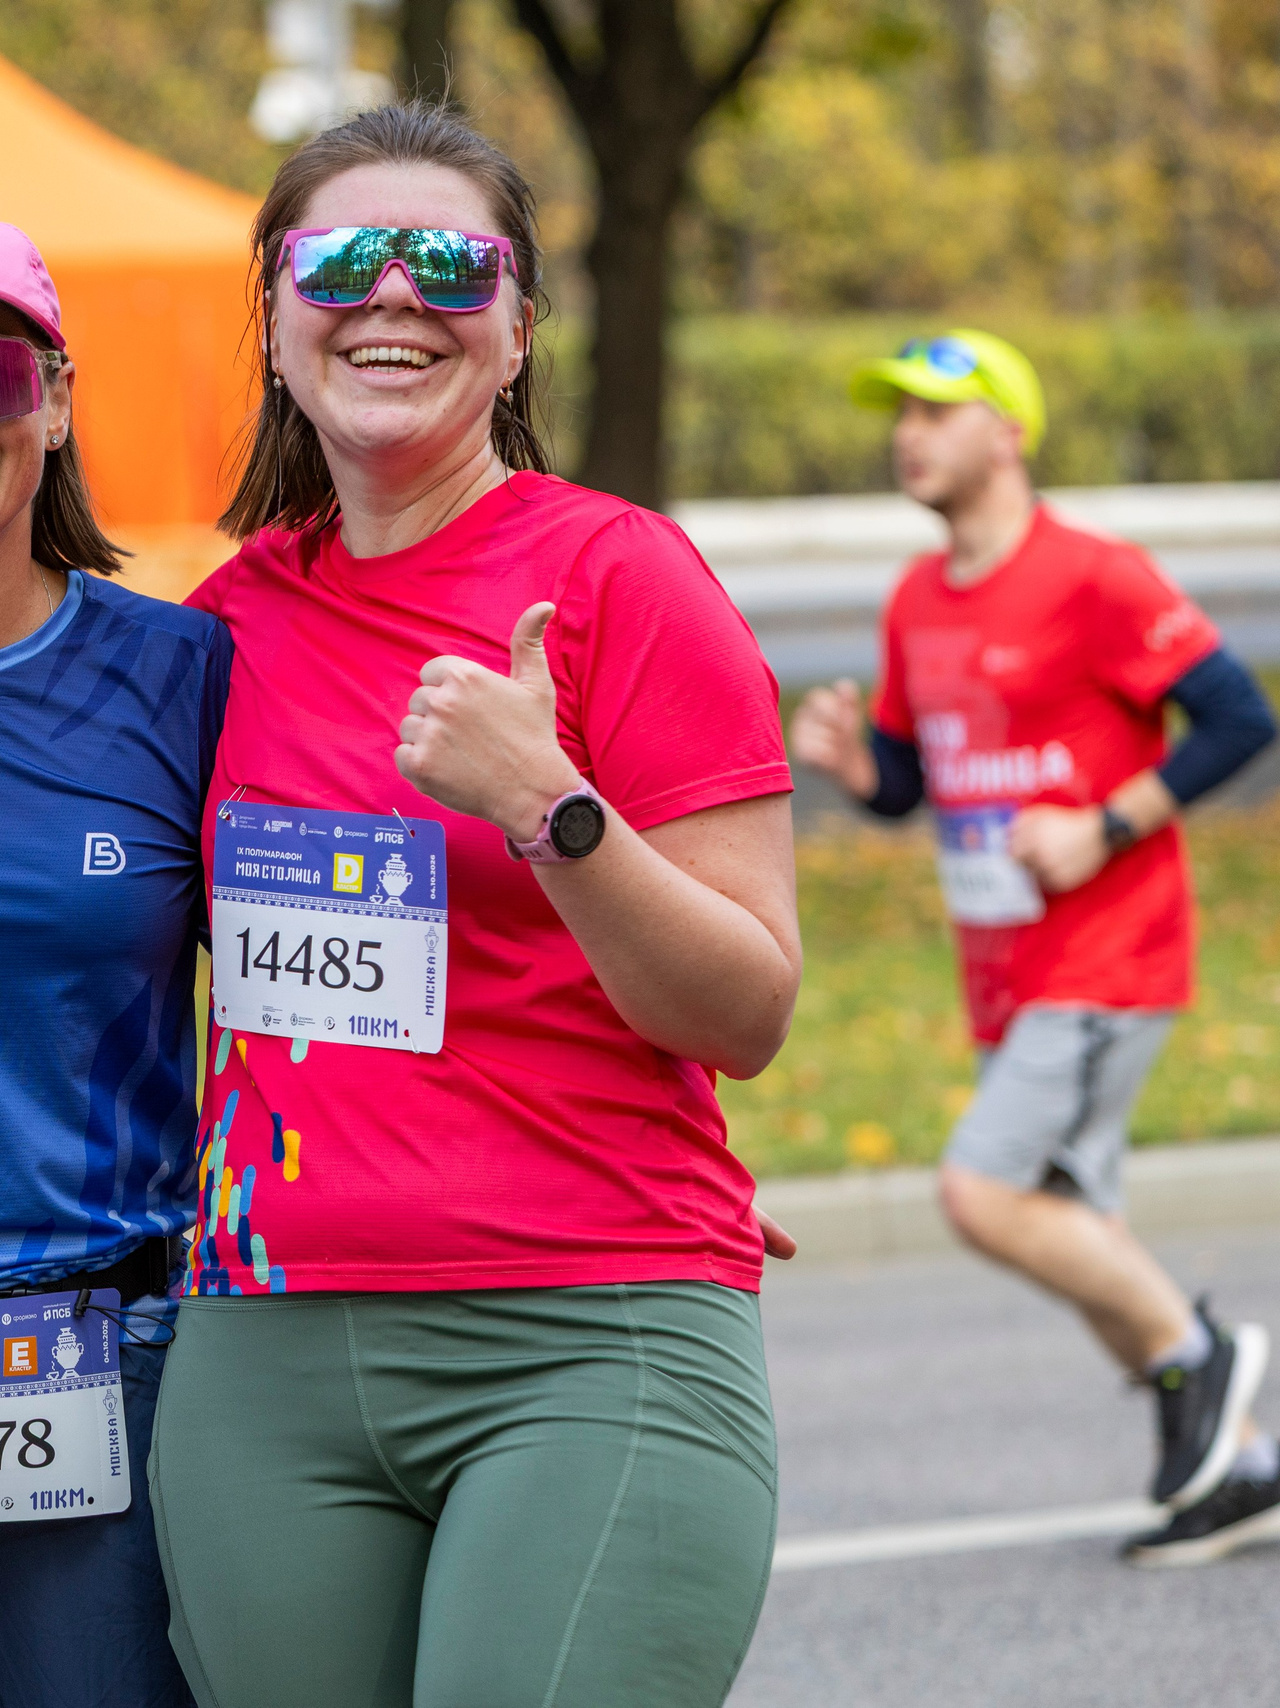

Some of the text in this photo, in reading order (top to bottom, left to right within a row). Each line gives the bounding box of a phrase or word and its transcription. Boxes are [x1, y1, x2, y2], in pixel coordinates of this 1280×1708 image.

[384, 832, 405, 845] ПСБ
[244, 847, 303, 862] ПОЛУМАРАФОН
[235, 861, 321, 885] МОЯ СТОЛИЦА
[337, 856, 361, 884] D
[429, 854, 437, 900] 04.10.2026
[236, 926, 384, 993] 14485
[424, 955, 437, 1016] МОСКВА
[348, 1014, 398, 1039] 10КМ
[52, 1307, 71, 1320] ПСБ
[11, 1341, 30, 1366] E
[102, 1319, 110, 1364] 04.10.2026
[8, 1365, 33, 1373] КЛАСТЕР
[107, 1417, 122, 1477] МОСКВА
[29, 1487, 85, 1511] 10КМ
